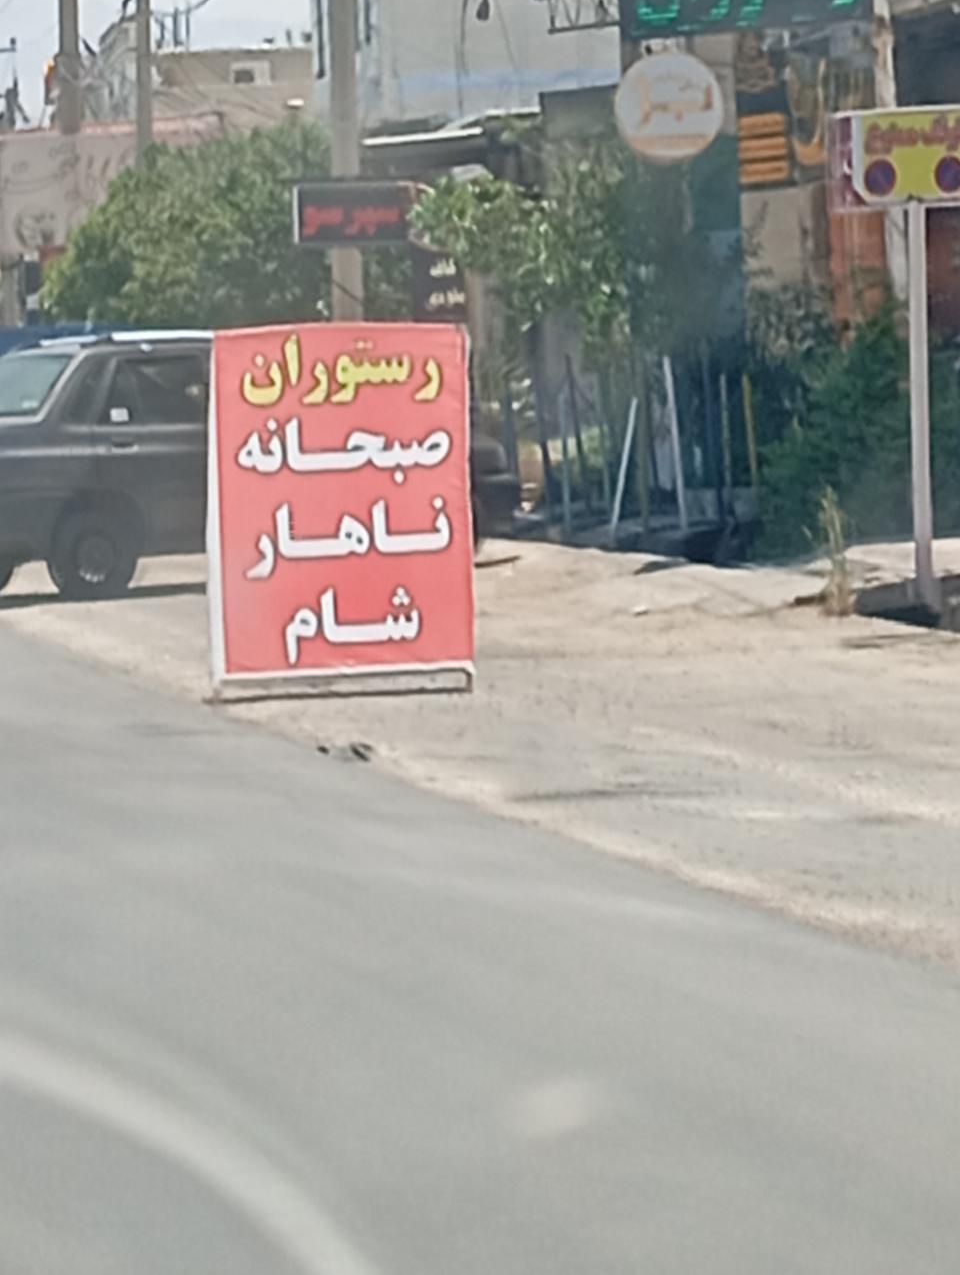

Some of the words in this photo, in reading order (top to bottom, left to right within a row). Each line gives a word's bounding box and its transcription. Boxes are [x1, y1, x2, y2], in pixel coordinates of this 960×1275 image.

[241, 334, 441, 406] رستوران
[236, 417, 453, 485] صبحانه
[245, 496, 453, 581] ناهار
[283, 585, 421, 666] شام
